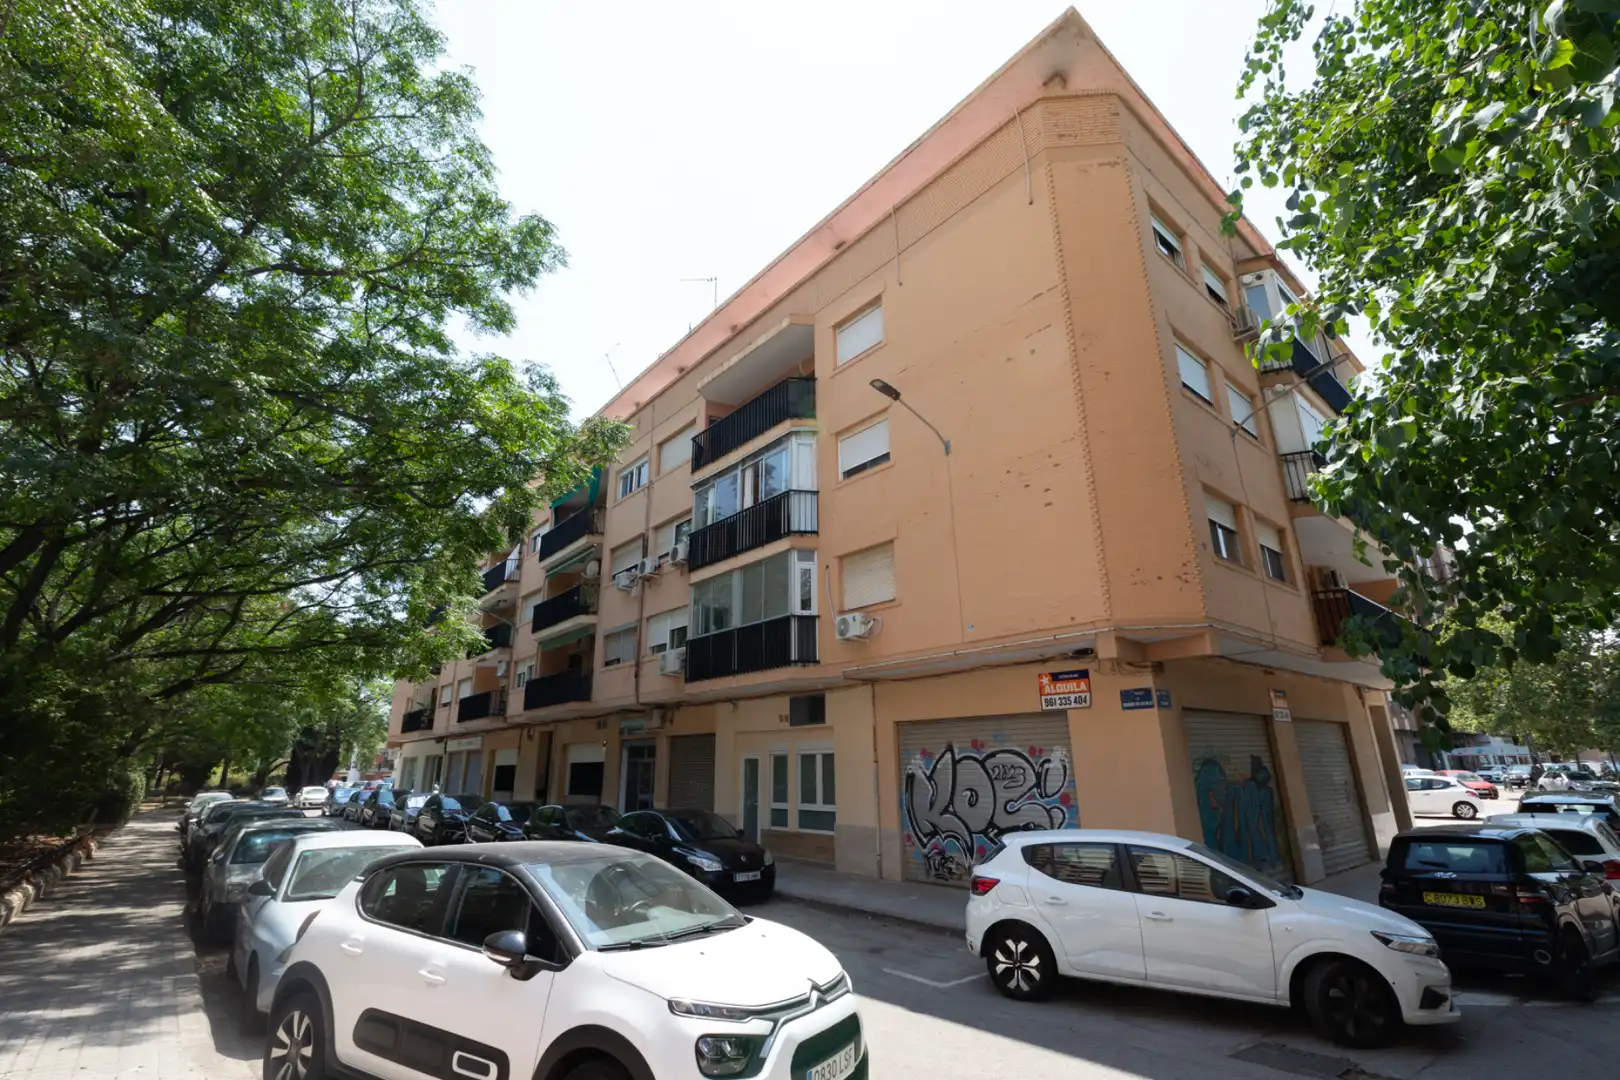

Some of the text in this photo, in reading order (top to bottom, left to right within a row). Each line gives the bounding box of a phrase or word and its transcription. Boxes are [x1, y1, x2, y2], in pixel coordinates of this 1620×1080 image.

[1044, 681, 1087, 694] ALQUILA
[1044, 695, 1087, 707] 961 335 404
